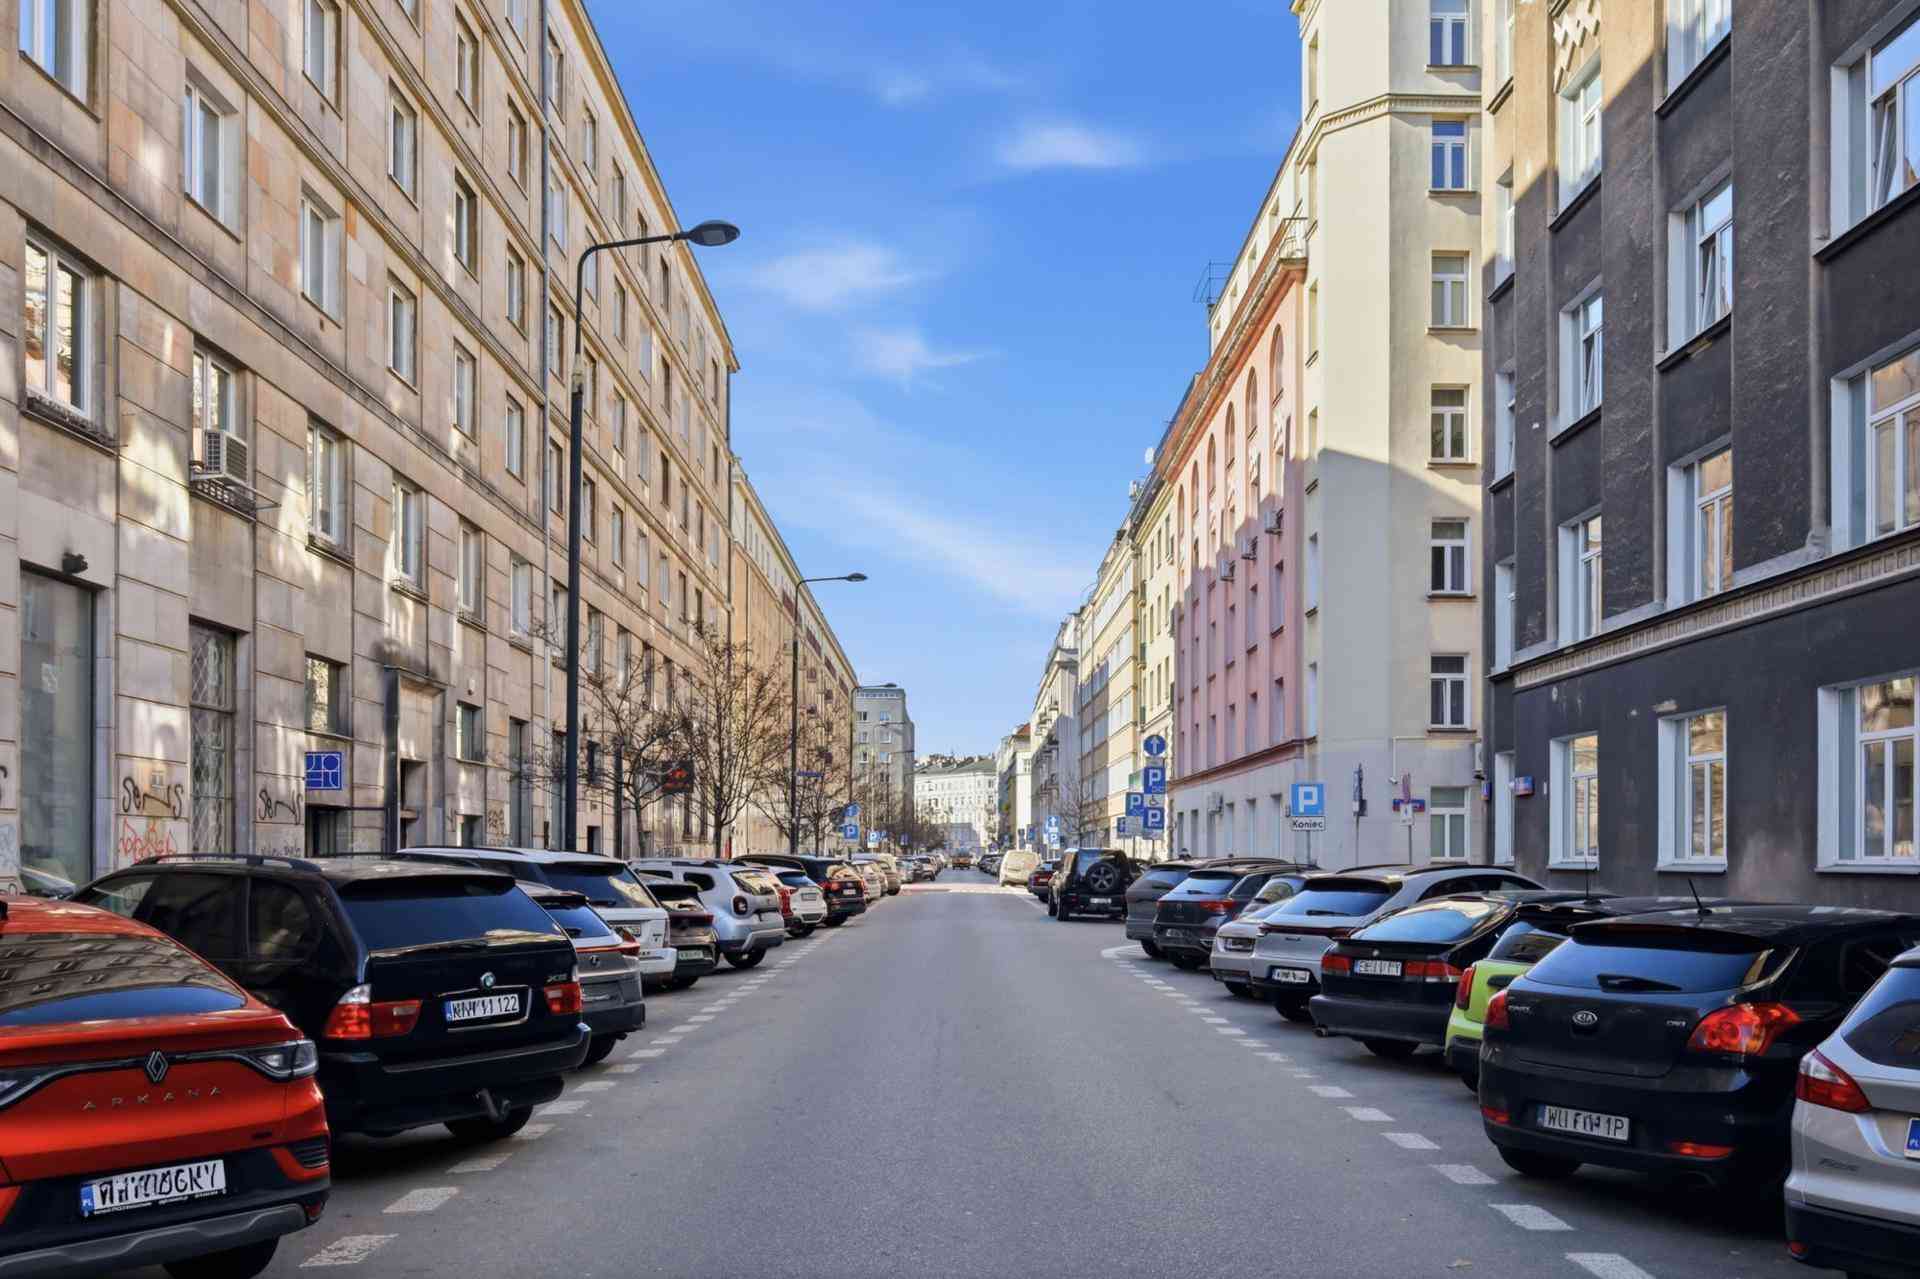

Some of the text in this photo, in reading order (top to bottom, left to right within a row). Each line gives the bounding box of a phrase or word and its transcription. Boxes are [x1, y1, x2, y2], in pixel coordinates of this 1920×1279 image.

[1149, 769, 1162, 786] P
[1130, 795, 1142, 810] P
[1298, 786, 1318, 813] P
[1148, 809, 1161, 827] P
[1292, 819, 1323, 829] Koniec
[846, 825, 856, 838] P
